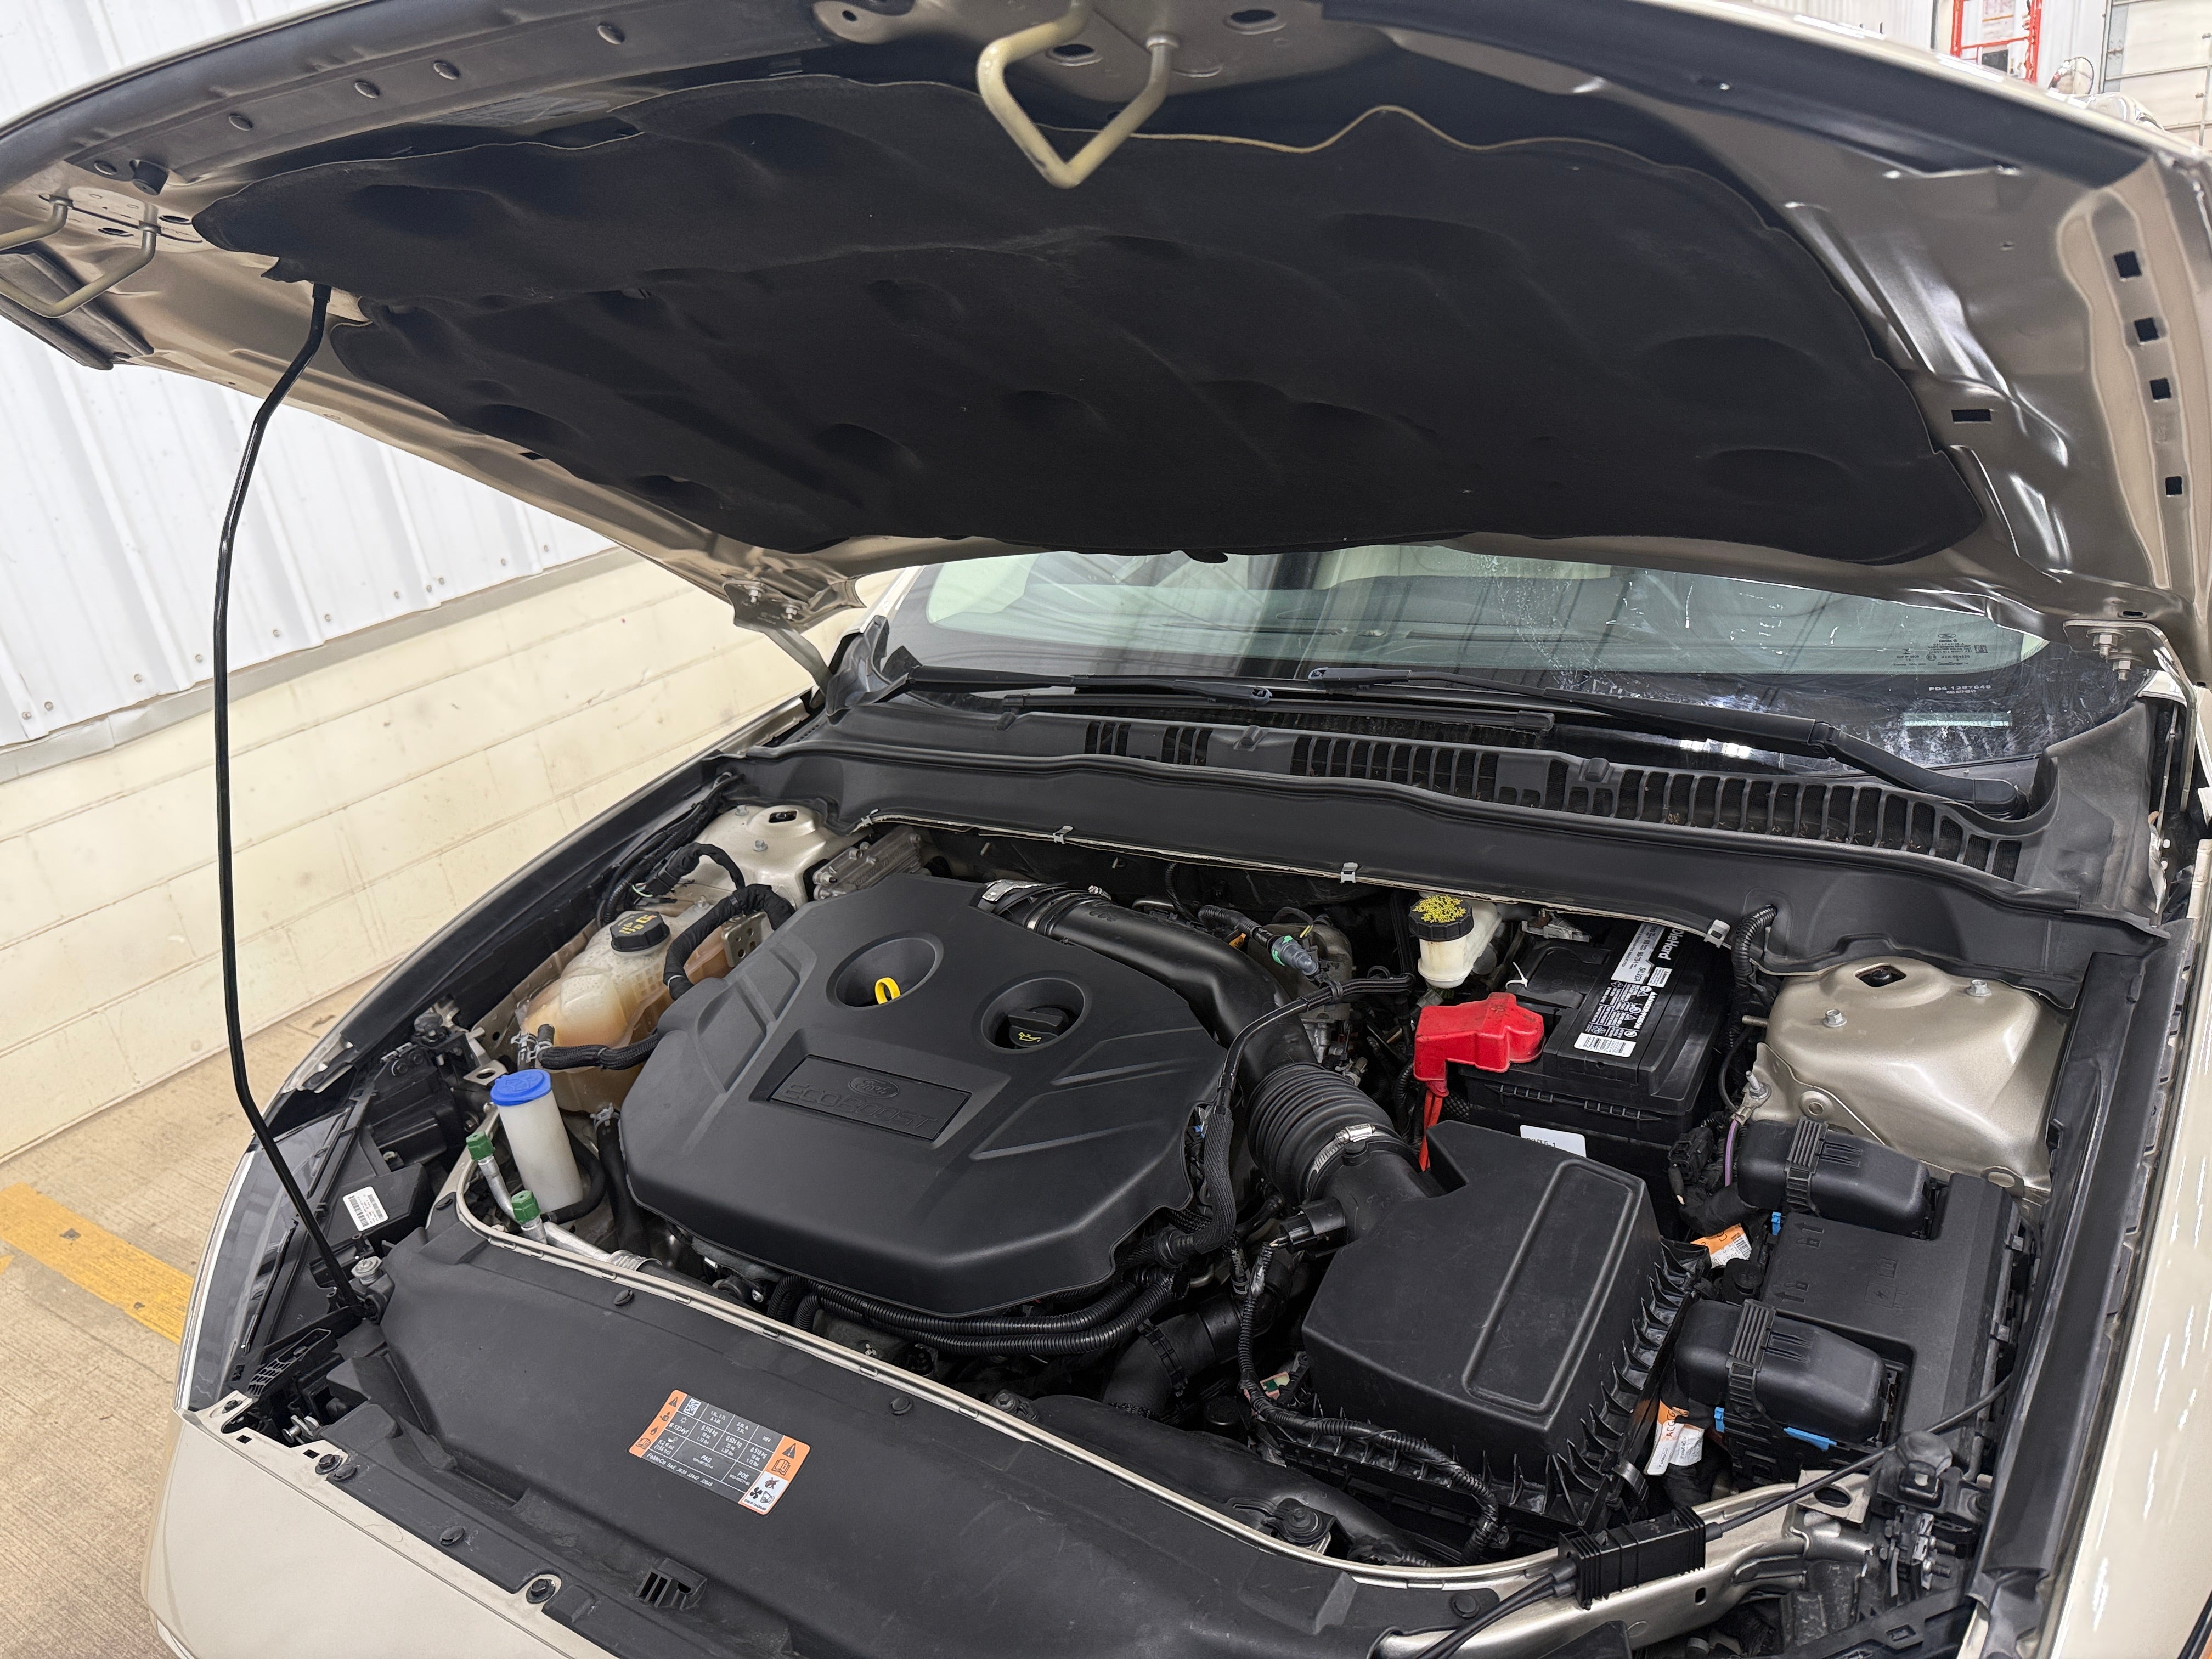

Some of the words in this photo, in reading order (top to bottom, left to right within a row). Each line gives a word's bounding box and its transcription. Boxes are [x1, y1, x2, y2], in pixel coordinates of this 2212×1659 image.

[1658, 928, 1685, 960] DieHard
[1633, 967, 1646, 982] SILVER
[668, 1422, 690, 1435] R-1234yf
[736, 1440, 743, 1448] kg
[646, 1452, 667, 1465] FoMoCo
[700, 1454, 713, 1463] PAG
[760, 1451, 768, 1459] kg
[737, 1471, 750, 1480] POE
